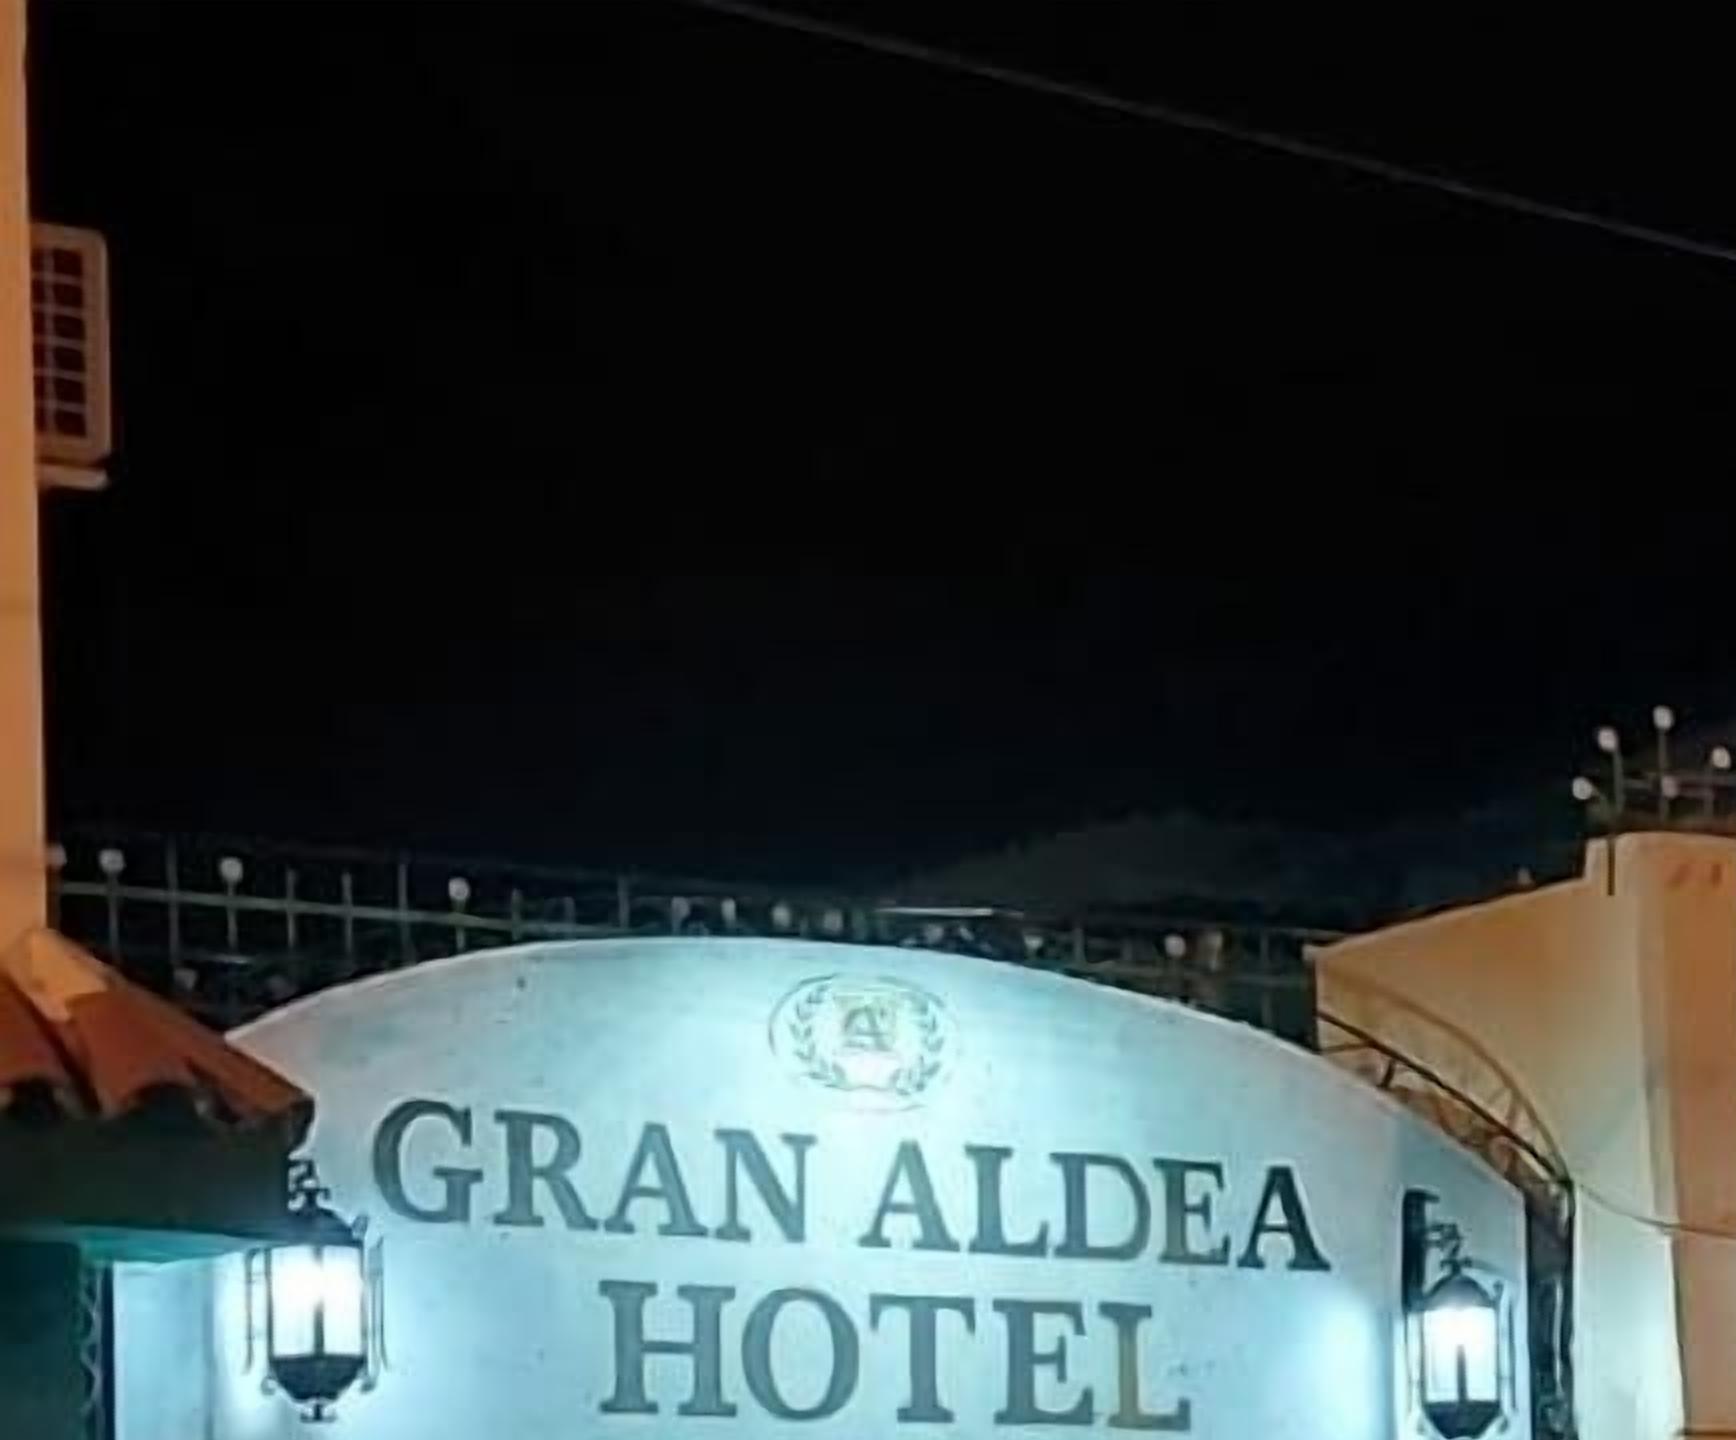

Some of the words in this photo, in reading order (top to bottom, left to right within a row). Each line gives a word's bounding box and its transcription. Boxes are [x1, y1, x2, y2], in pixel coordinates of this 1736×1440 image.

[371, 1099, 817, 1244] GRAN
[859, 1139, 1331, 1272] ALDEA
[599, 1280, 1192, 1432] HOTEL
